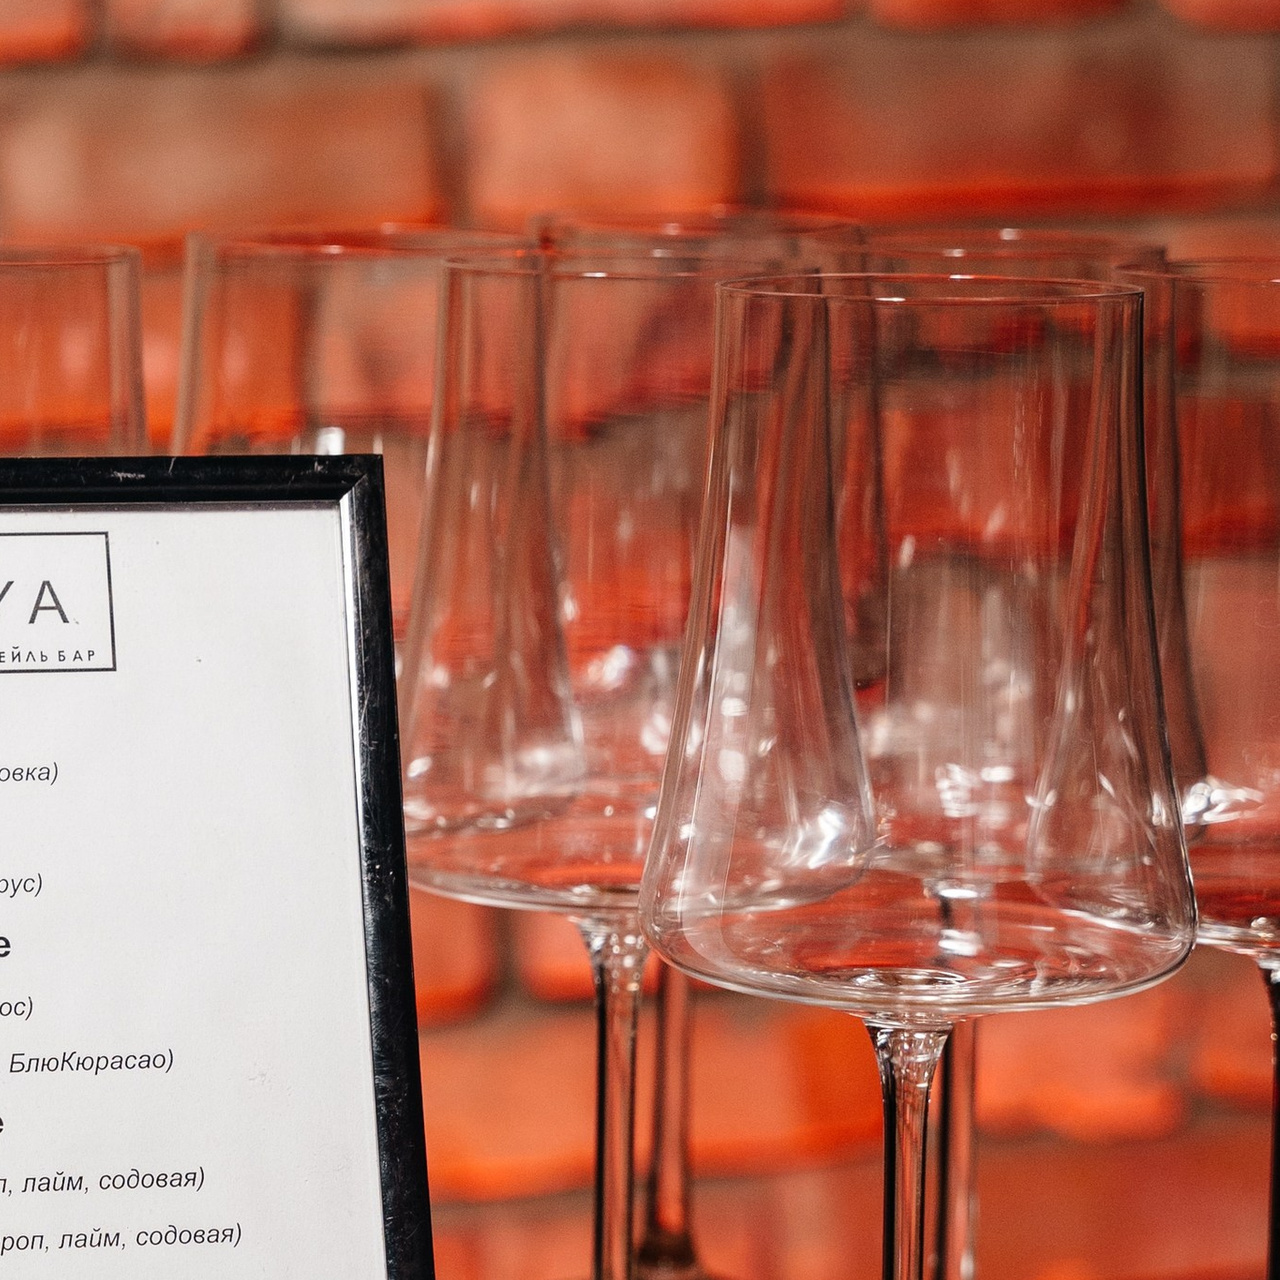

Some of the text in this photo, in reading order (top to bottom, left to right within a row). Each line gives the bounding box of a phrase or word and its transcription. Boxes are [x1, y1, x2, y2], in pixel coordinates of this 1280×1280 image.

[57, 649, 95, 663] БАР
[9, 1048, 174, 1076] БлюКюрасао)
[21, 1170, 89, 1195] лайм,
[98, 1166, 205, 1193] содовая)
[57, 1227, 126, 1251] лайм,
[135, 1222, 242, 1249] содовая)
